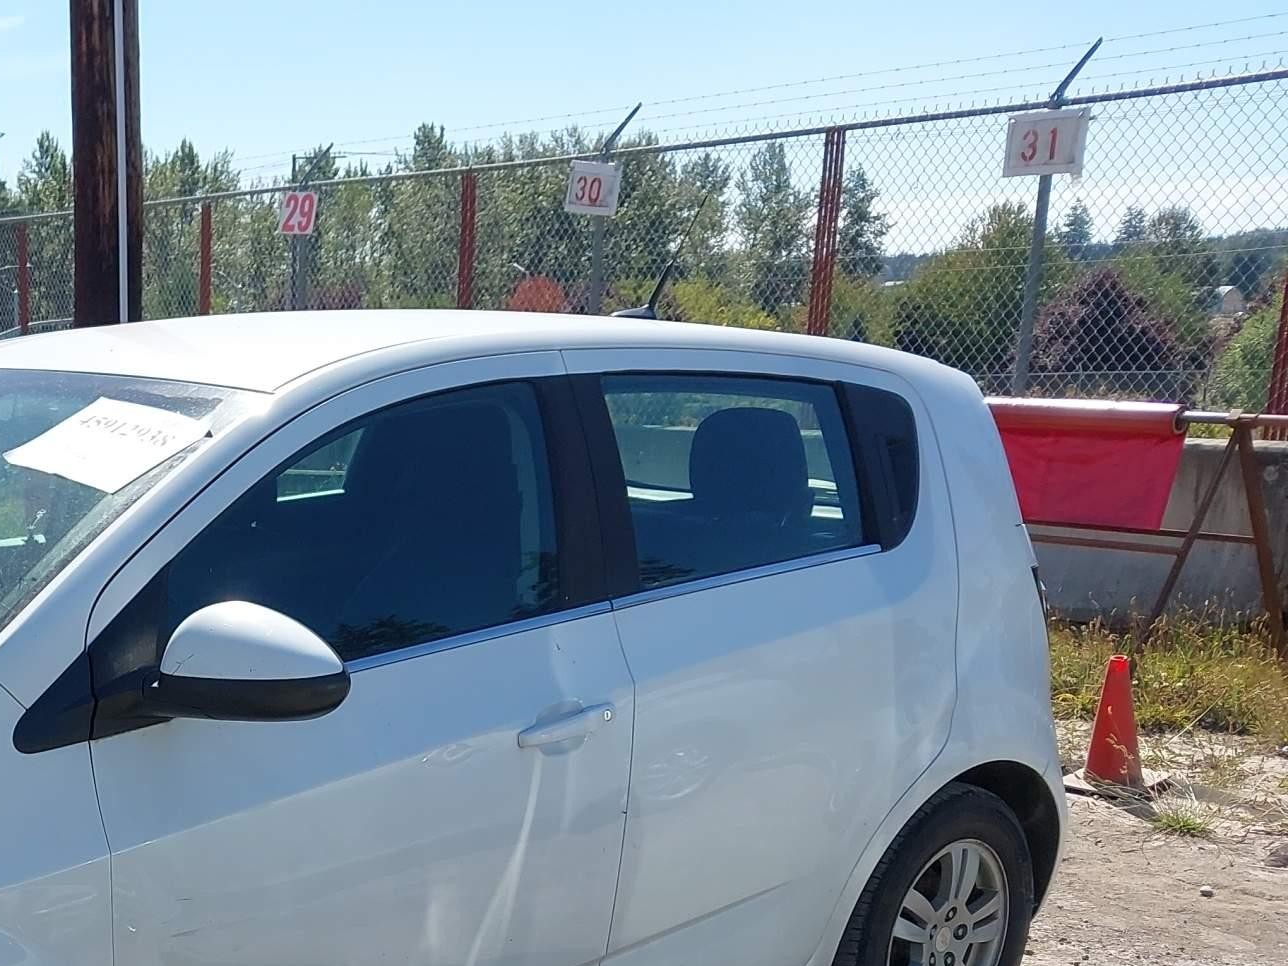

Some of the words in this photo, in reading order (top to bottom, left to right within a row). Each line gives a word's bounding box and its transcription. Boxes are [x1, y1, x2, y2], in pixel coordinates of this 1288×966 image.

[1021, 128, 1058, 162] 31
[575, 176, 601, 204] 30
[281, 193, 314, 232] 29
